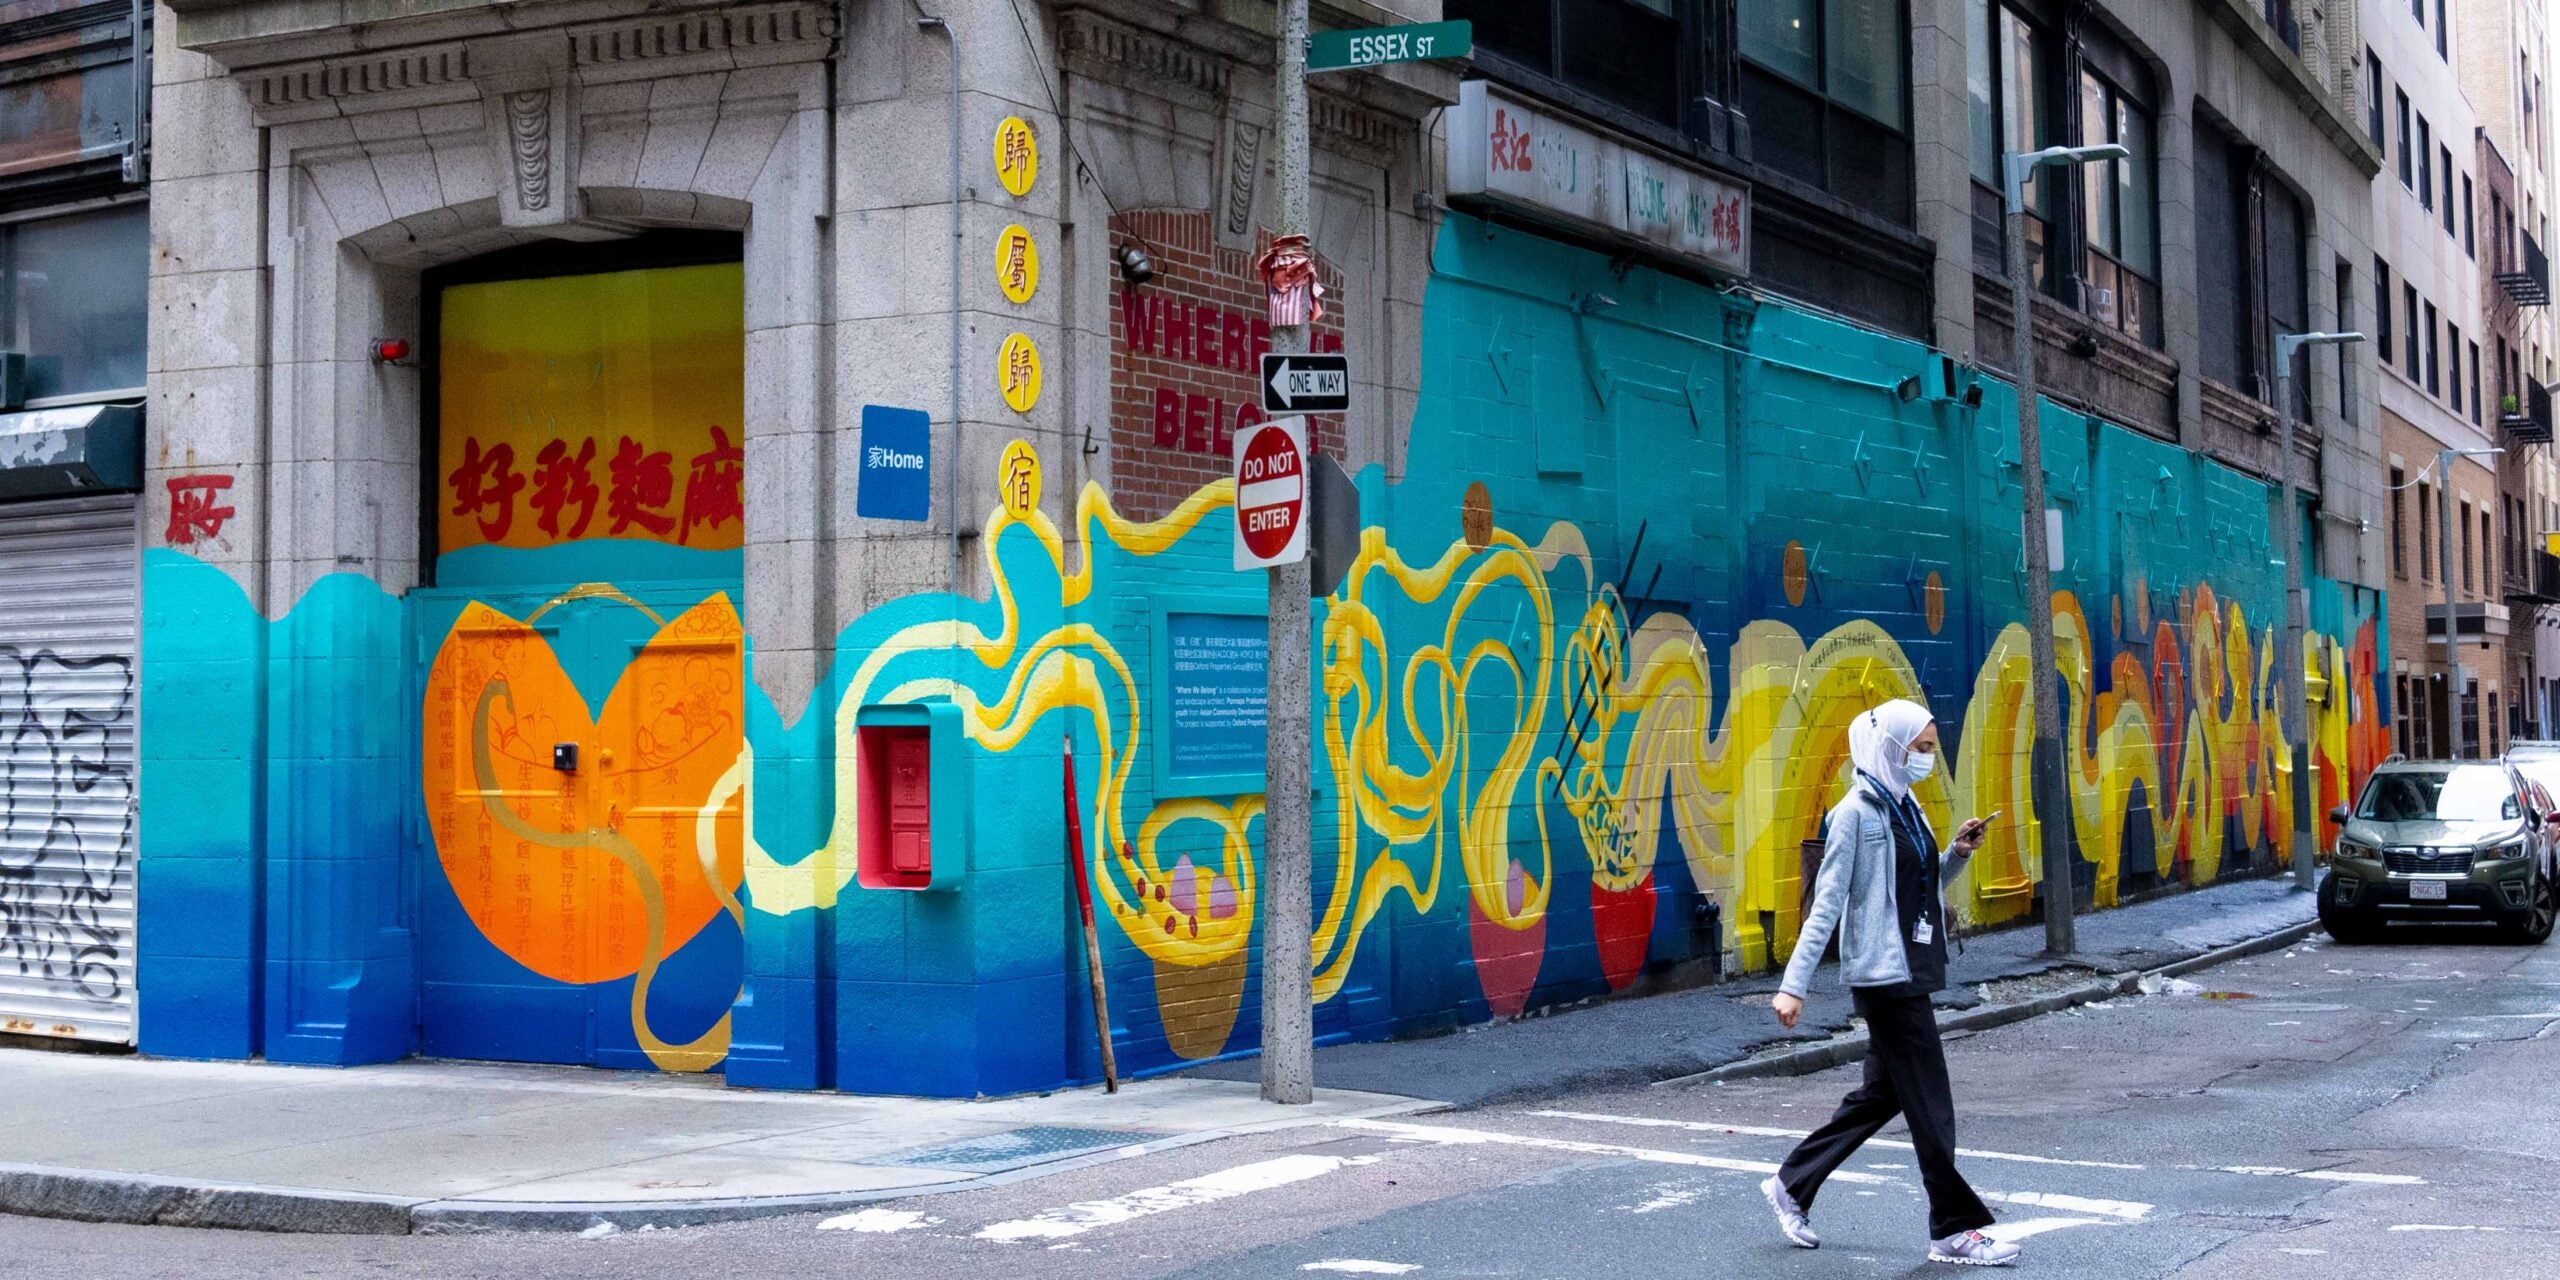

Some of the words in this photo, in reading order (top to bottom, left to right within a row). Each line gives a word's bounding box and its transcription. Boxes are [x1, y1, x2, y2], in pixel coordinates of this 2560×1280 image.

[1350, 33, 1409, 64] ESSEX
[1416, 37, 1435, 57] ST
[1490, 108, 1532, 172] 長江
[1120, 288, 1271, 375] WHERE
[1289, 373, 1311, 393] ONE
[1318, 372, 1341, 393] WAY
[1245, 460, 1263, 479] DO
[1268, 451, 1294, 474] NOT
[1249, 507, 1290, 532] ENTER
